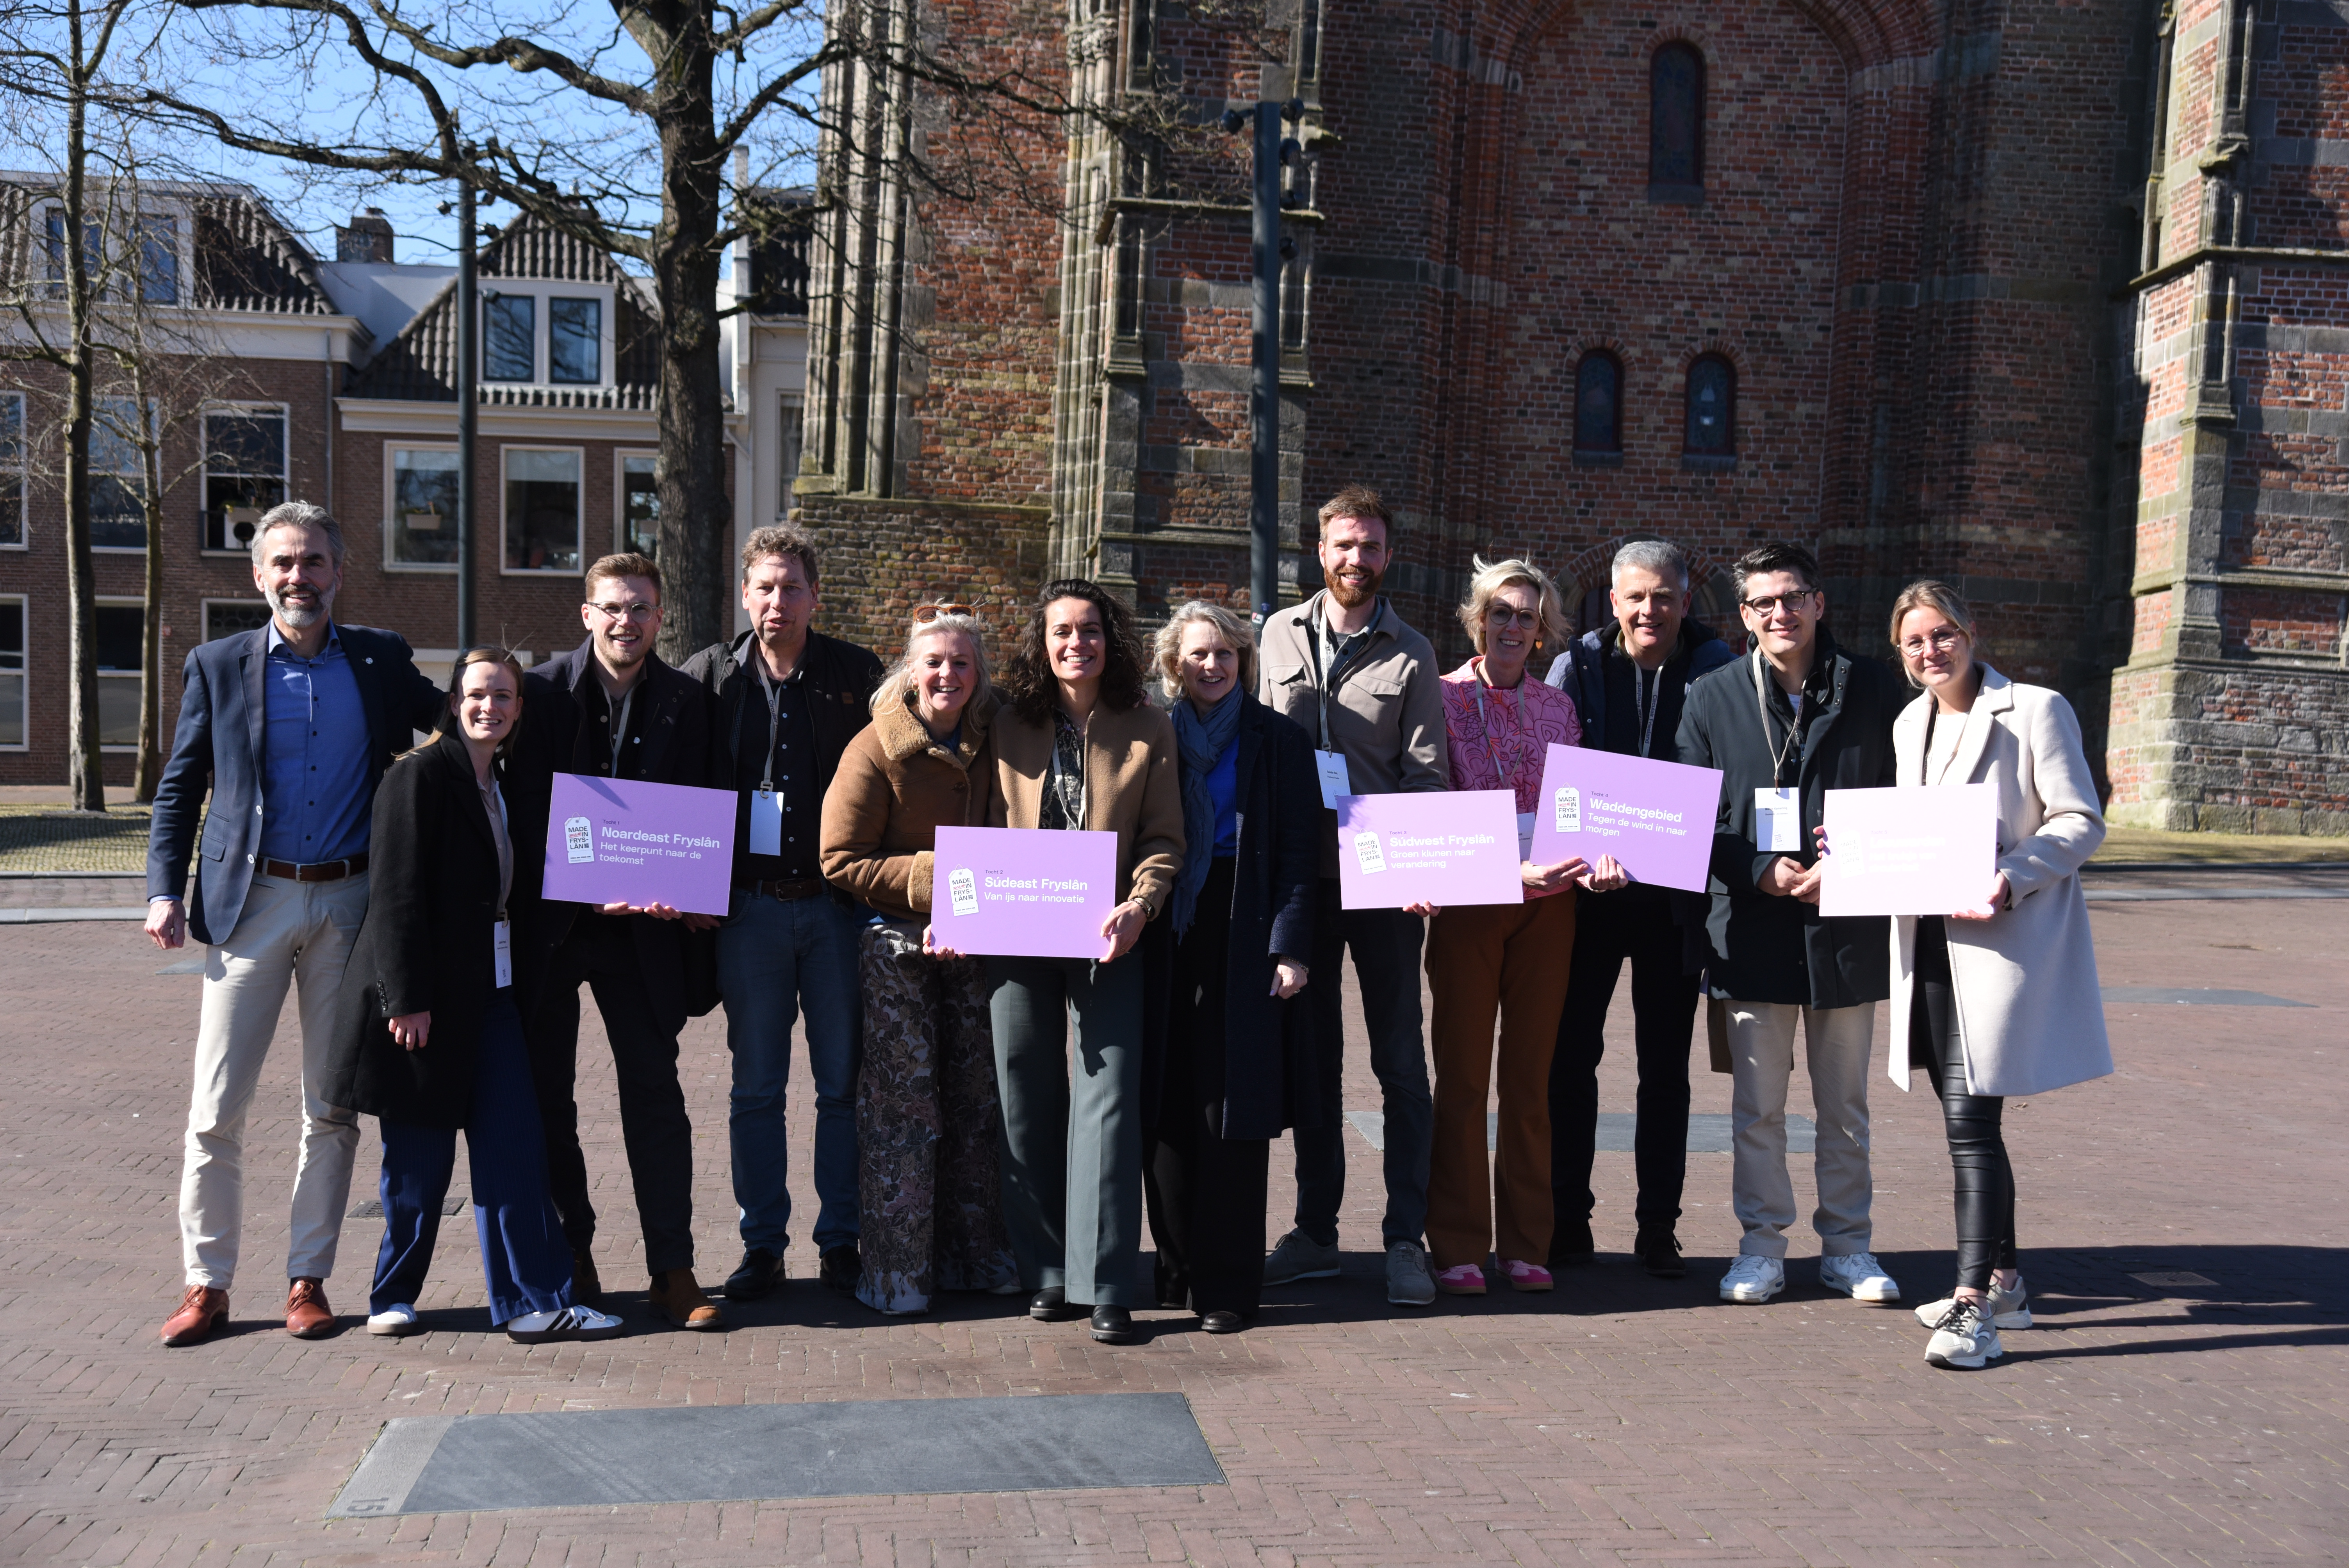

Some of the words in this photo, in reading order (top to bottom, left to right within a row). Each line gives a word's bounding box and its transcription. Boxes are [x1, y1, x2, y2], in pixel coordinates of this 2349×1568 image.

[768, 699, 778, 723] Circulair
[1645, 719, 1653, 744] Friesland
[1590, 798, 1682, 823] Waddengebied
[1585, 825, 1620, 836] morgen
[1588, 813, 1615, 825] Tegen
[1618, 818, 1629, 827] de
[1632, 820, 1654, 830] wind
[1656, 823, 1664, 832] in
[1666, 827, 1687, 836] naar
[602, 827, 670, 843] Noardeast
[673, 834, 720, 848] Fryslân
[1390, 836, 1445, 847] Súdwest
[1448, 834, 1495, 847] Fryslân
[1840, 839, 1857, 848] MADE
[600, 841, 617, 851] Het
[620, 843, 663, 855] keerpunt
[690, 851, 702, 859] de
[599, 853, 644, 865] toekomst
[1390, 859, 1446, 869] verandering
[984, 877, 1037, 889] Súdeast
[1041, 878, 1087, 892] Fryslân
[984, 892, 1002, 900] Van
[1005, 892, 1015, 903] ijs
[1042, 893, 1085, 903] innovatie
[347, 1497, 389, 1511] 15
